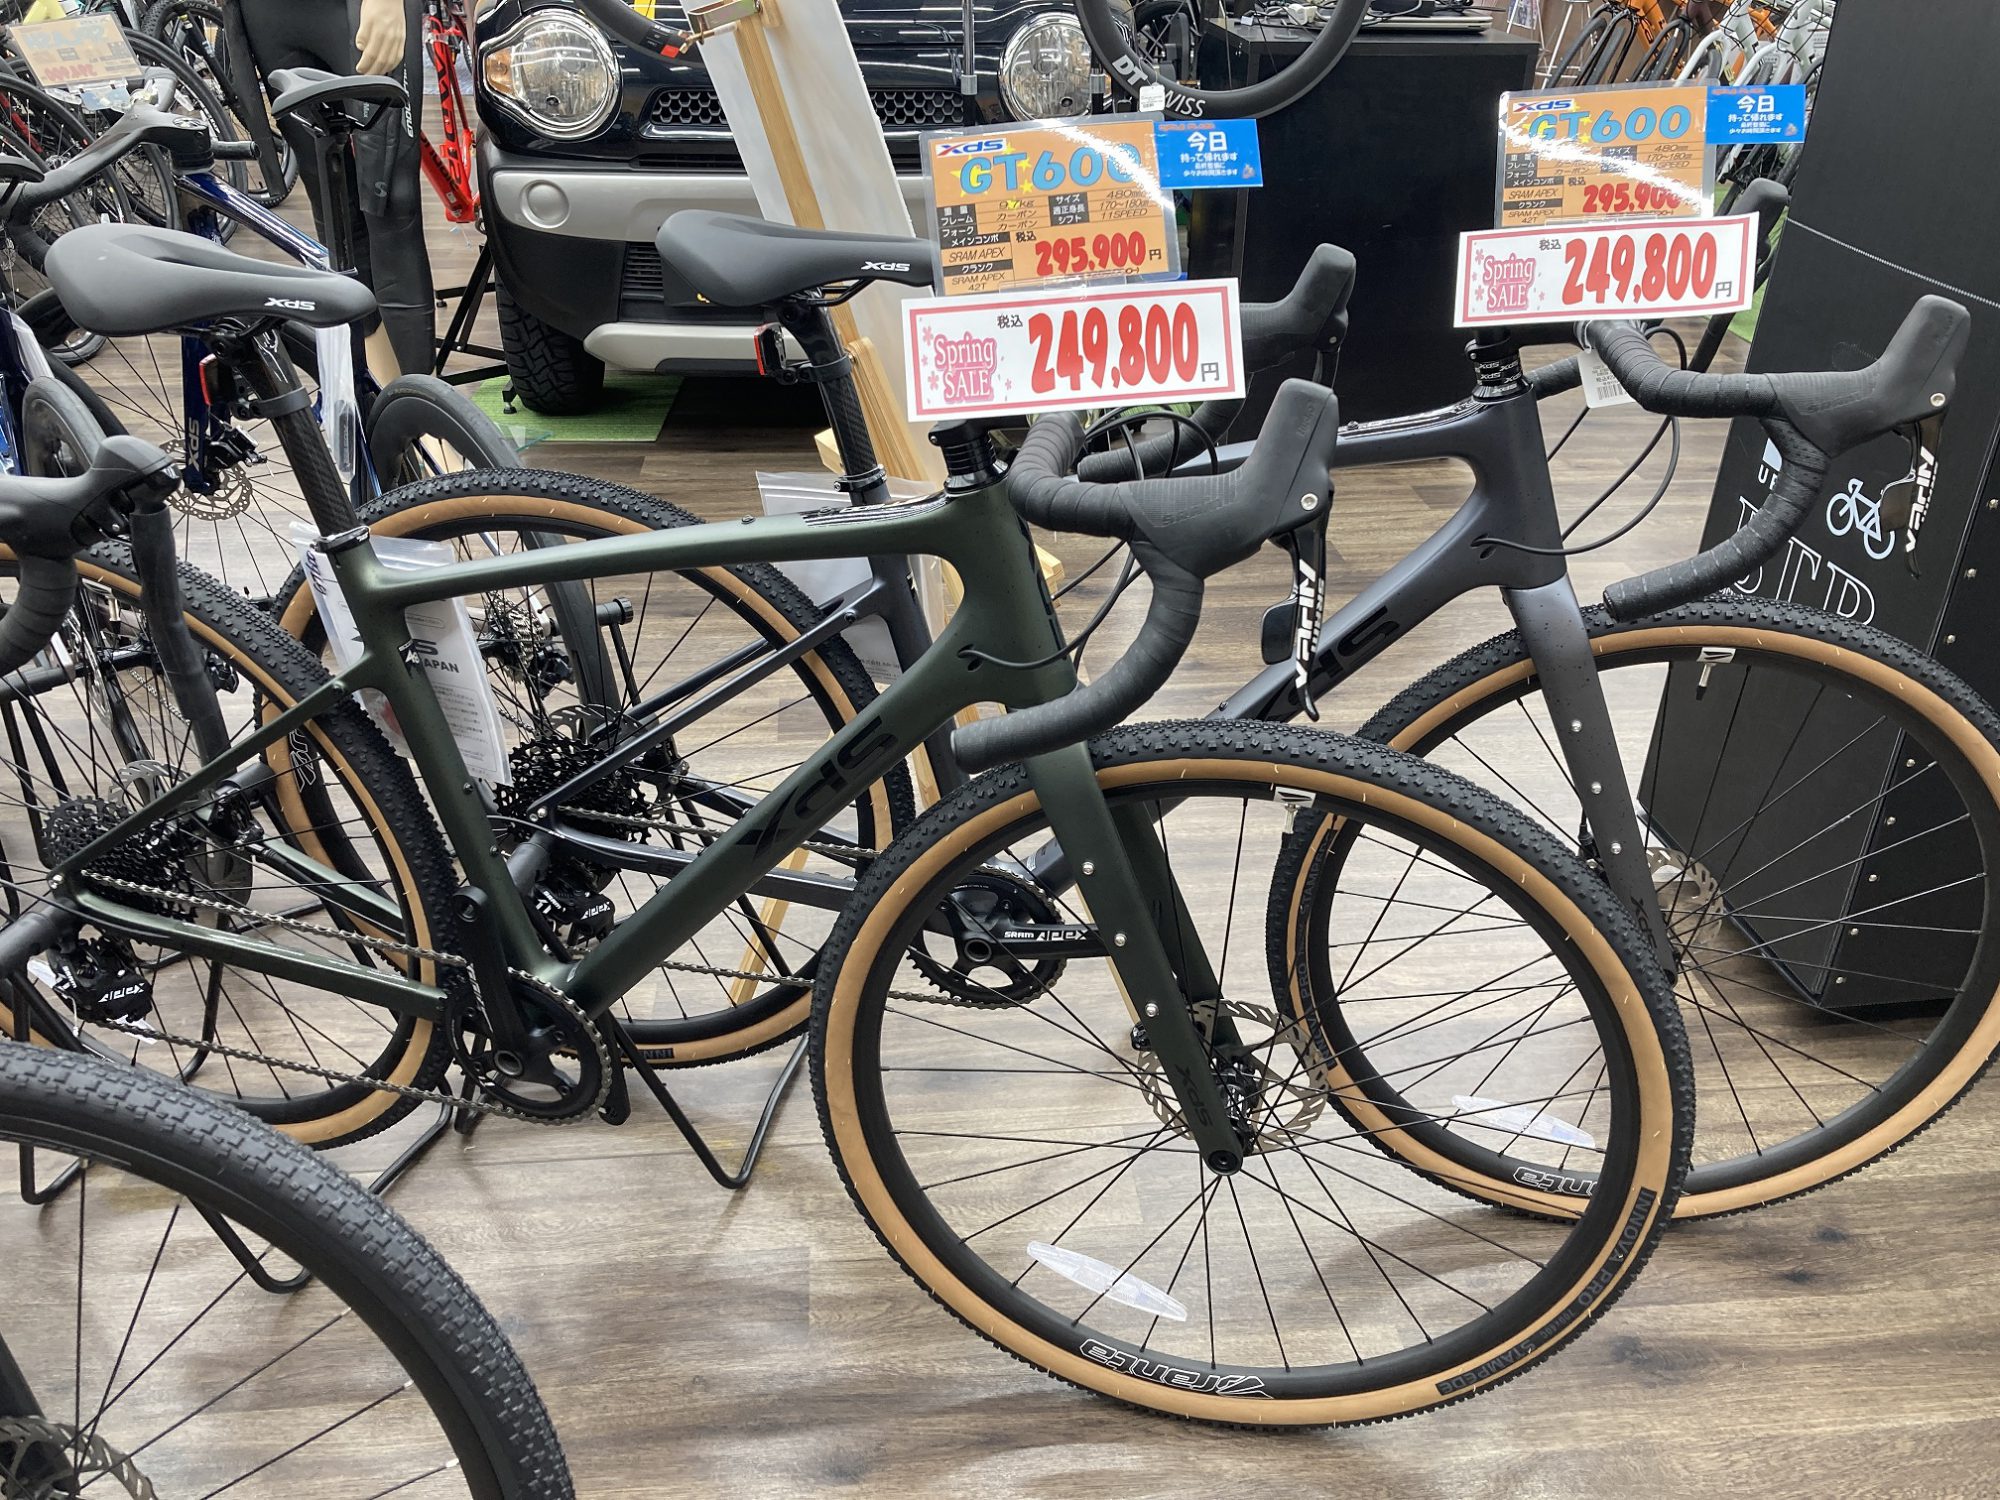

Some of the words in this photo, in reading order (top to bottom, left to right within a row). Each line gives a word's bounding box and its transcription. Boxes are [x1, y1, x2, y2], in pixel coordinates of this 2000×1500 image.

[1112, 54, 1148, 85] DT
[1737, 95, 1774, 112] 今日
[1187, 131, 1227, 151] 今日
[1507, 170, 1534, 179] フォーク
[1513, 178, 1555, 187] メインコンポ
[1055, 194, 1080, 205] サイズ
[1508, 189, 1533, 199] SRAM
[1535, 188, 1558, 197] APEX
[1519, 200, 1546, 209] クランク
[1534, 208, 1555, 216] APEX
[941, 215, 974, 226] フレーム
[996, 210, 1036, 221] カーボン
[1058, 215, 1082, 225] シフト
[942, 226, 974, 238] フォーク
[997, 220, 1037, 232] カーボン
[951, 233, 999, 248] メインコンポ
[1016, 231, 1037, 243] 税込
[1539, 239, 1561, 250] 税込
[948, 250, 977, 263] SRAM
[979, 246, 1006, 260] APEX
[1149, 248, 1162, 260] 円
[961, 262, 994, 275] クランク
[1484, 254, 1533, 282] Spring
[1562, 232, 1717, 305] 249,800
[1715, 281, 1732, 298] 円
[951, 274, 978, 286] SRAM
[980, 271, 1006, 281] APEX
[967, 282, 987, 292] 42T
[1488, 284, 1528, 308] SALE
[997, 314, 1023, 329] 税込
[935, 334, 994, 366] Spring
[1028, 302, 1199, 394] 249,800
[1201, 362, 1220, 382] 円
[944, 370, 991, 398] SALE
[422, 659, 460, 674] APAN
[1608, 1189, 1655, 1263] INNOVA
[1578, 1269, 1612, 1306] PRO
[1440, 1340, 1535, 1394] STAMPEDE
